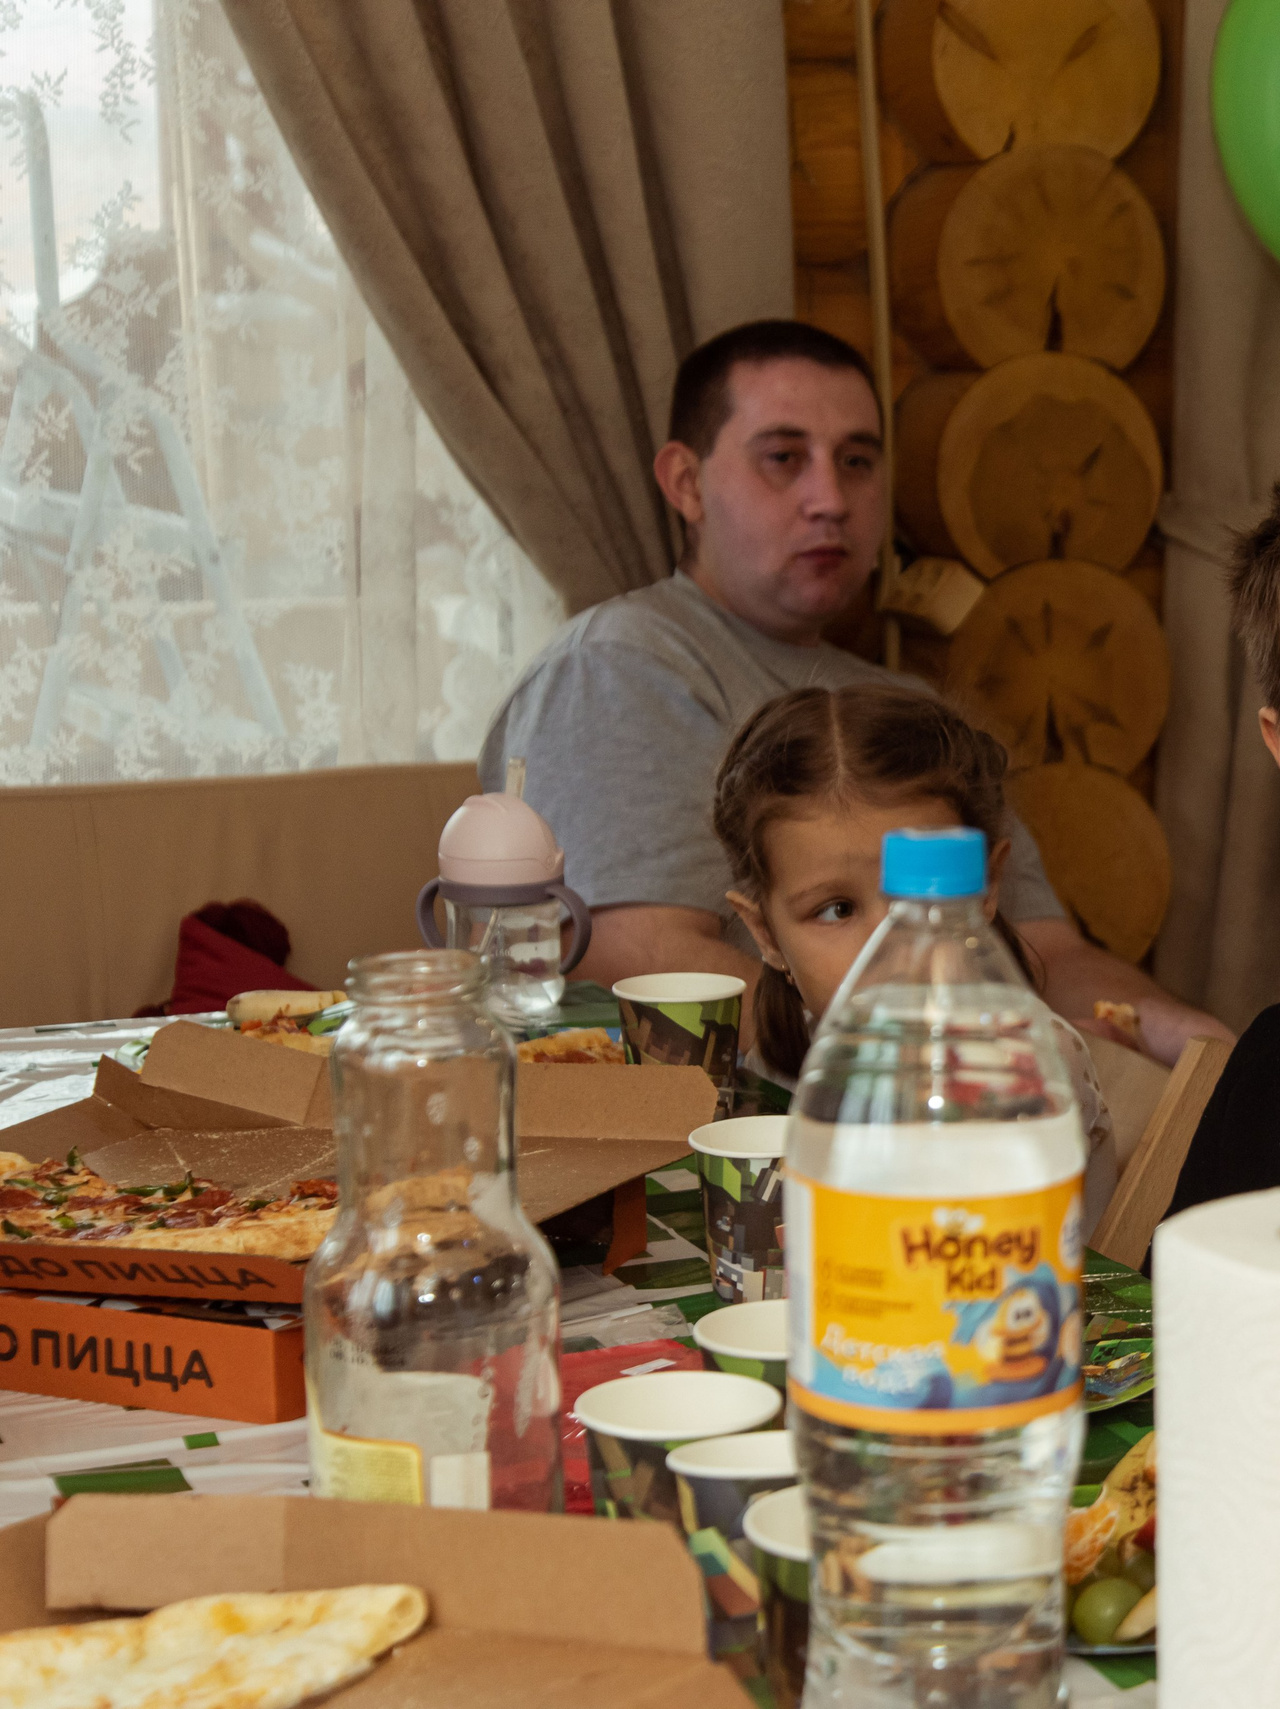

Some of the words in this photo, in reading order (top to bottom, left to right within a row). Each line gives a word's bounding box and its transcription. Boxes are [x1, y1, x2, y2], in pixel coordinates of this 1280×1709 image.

[901, 1223, 1039, 1267] Honey
[71, 1259, 276, 1291] ПИЦЦА
[945, 1262, 997, 1294] Kid
[31, 1328, 214, 1392] ПИЦЦА
